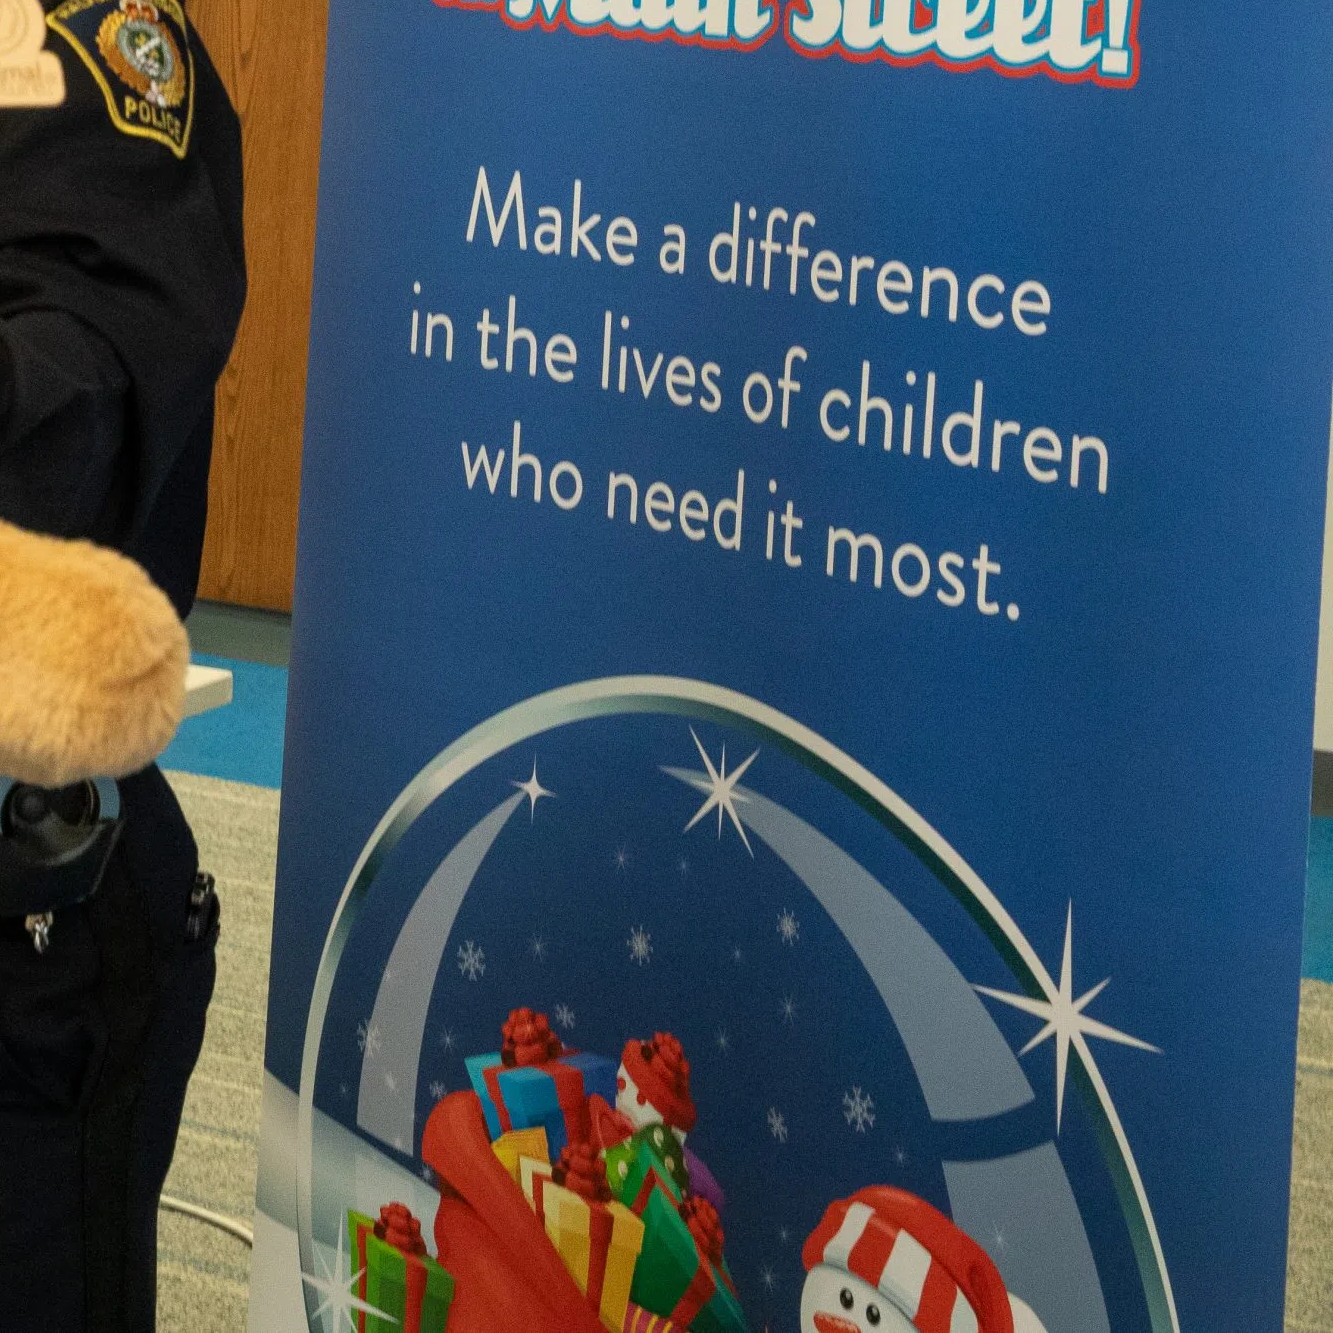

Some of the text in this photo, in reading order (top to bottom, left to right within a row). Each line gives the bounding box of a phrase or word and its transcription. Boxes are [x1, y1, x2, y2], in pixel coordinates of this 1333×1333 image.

[125, 97, 181, 142] POLICE
[465, 165, 1052, 337] Make a difference
[410, 280, 1110, 494] in the lives of children
[461, 420, 1020, 622] who need it most.
